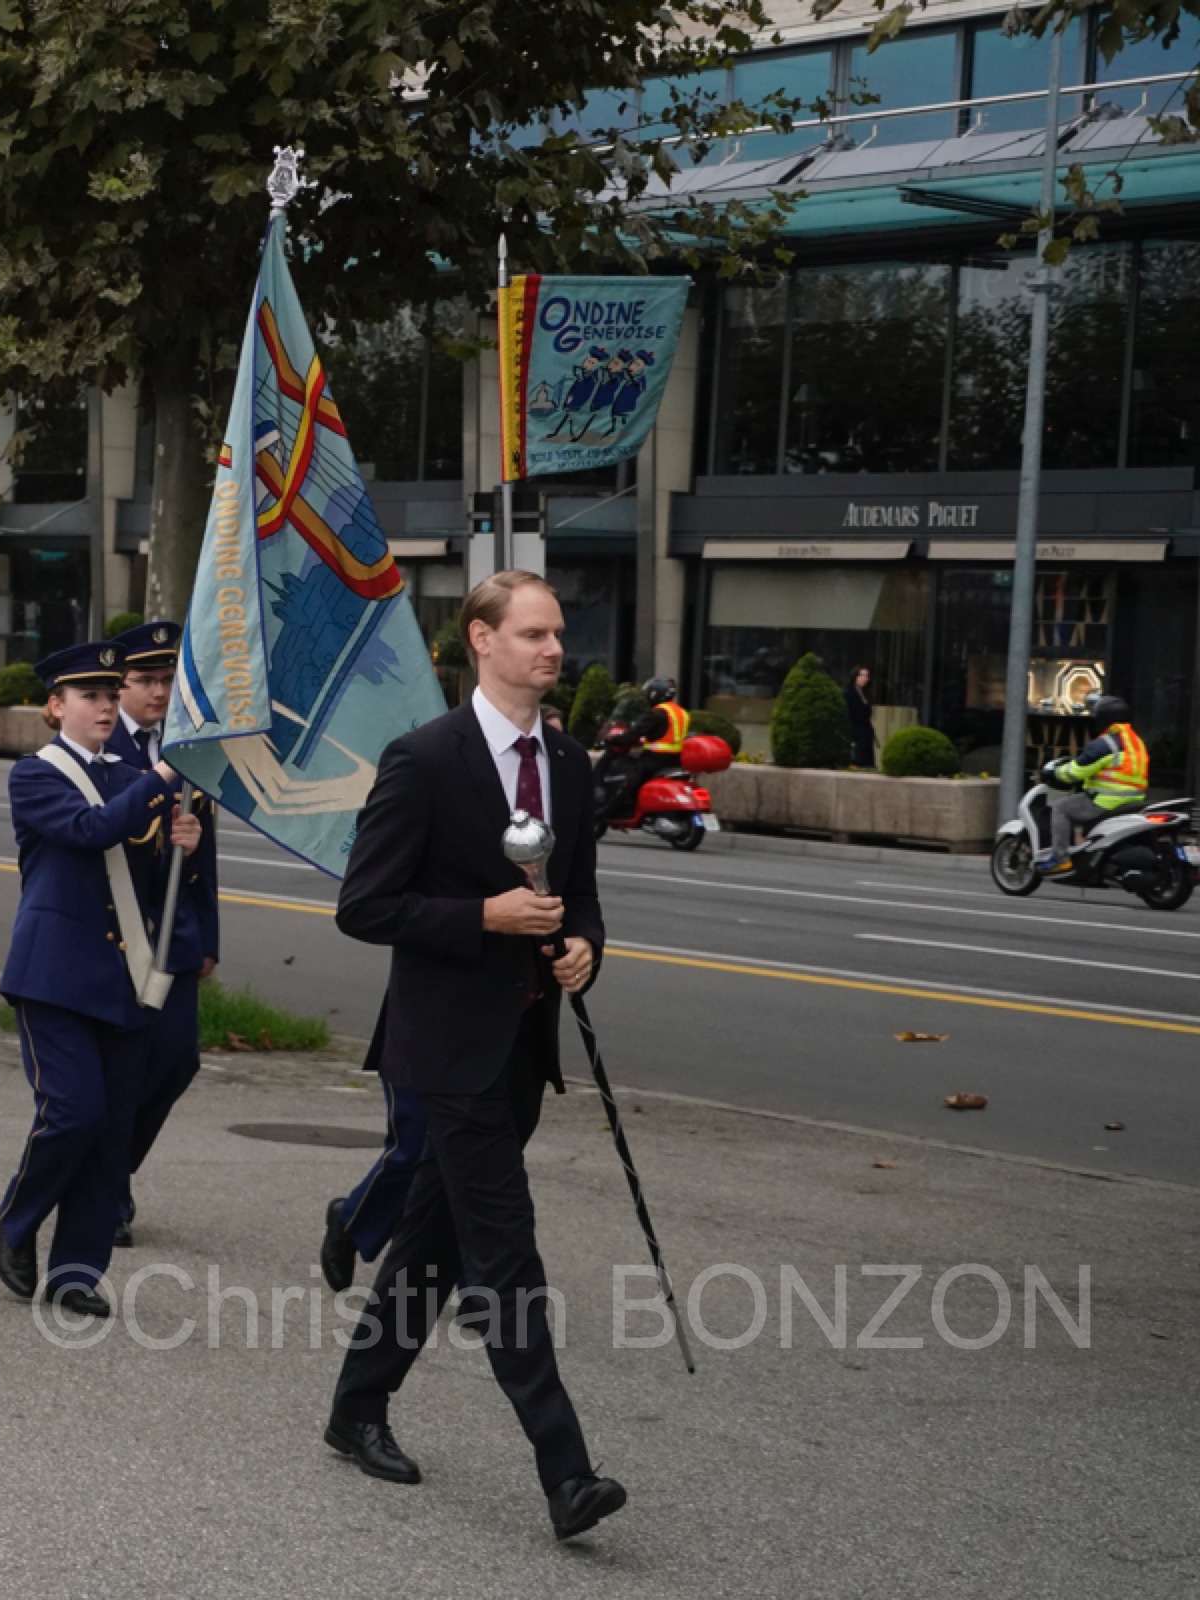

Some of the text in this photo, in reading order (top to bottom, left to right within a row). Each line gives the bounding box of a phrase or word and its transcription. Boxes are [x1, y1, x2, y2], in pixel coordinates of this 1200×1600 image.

[539, 296, 646, 332] ONDINE
[553, 325, 667, 353] GENEVOISE
[842, 501, 980, 527] AUDEMARS PIGUET
[215, 481, 258, 730] ONDINE GENEVOISE
